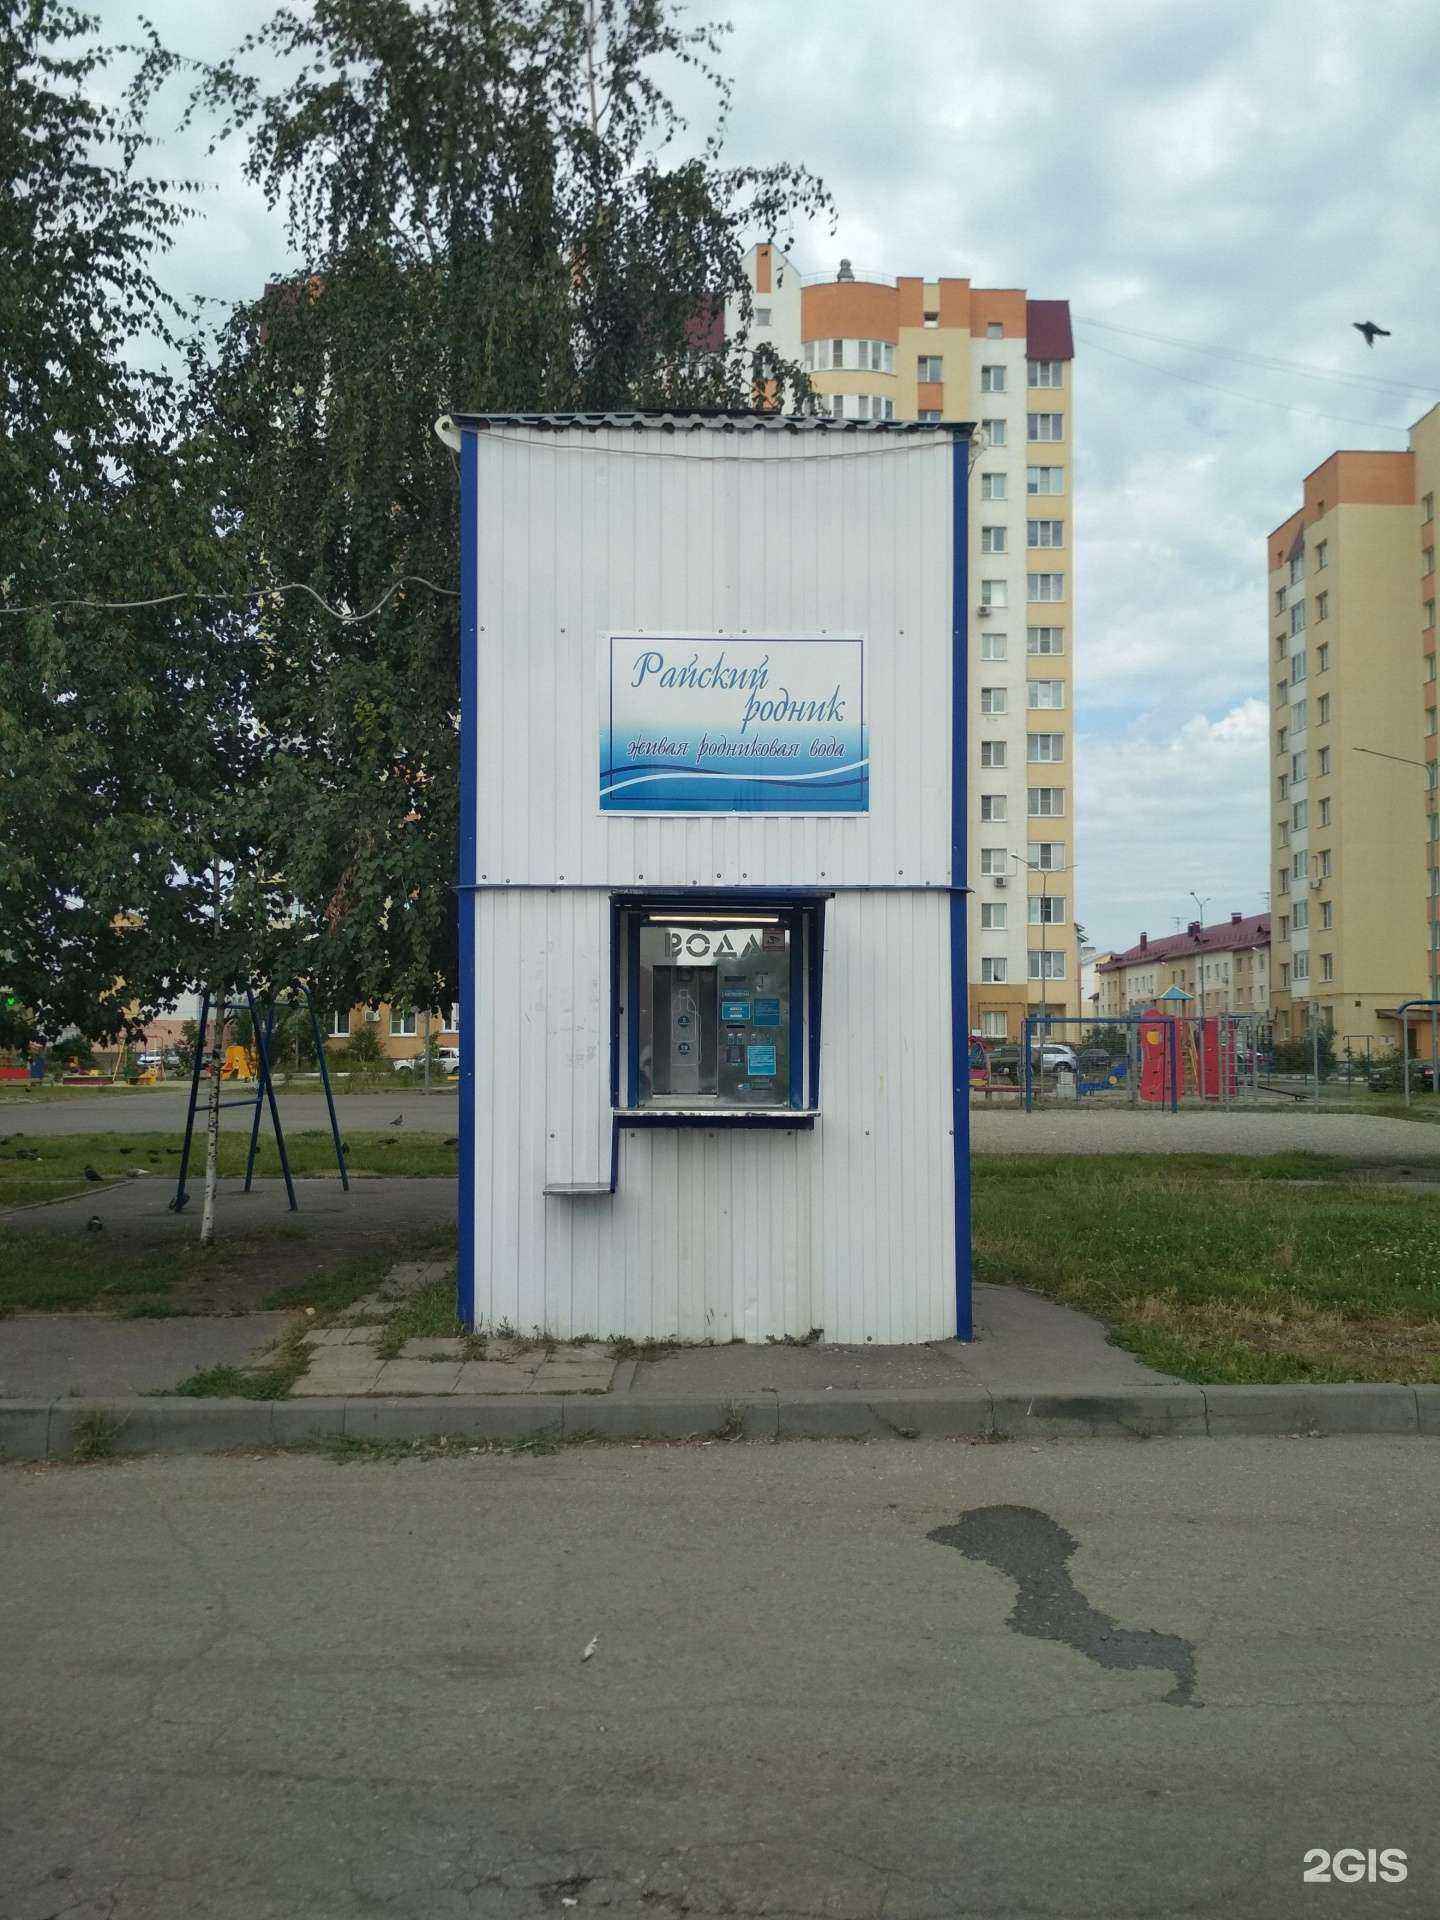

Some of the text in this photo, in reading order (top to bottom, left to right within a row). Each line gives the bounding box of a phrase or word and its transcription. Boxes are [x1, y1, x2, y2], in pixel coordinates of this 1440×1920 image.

[631, 651, 769, 689] Райский
[741, 685, 846, 734] родник
[627, 732, 847, 764] живая родниковая вода
[664, 932, 762, 957] ВОДА
